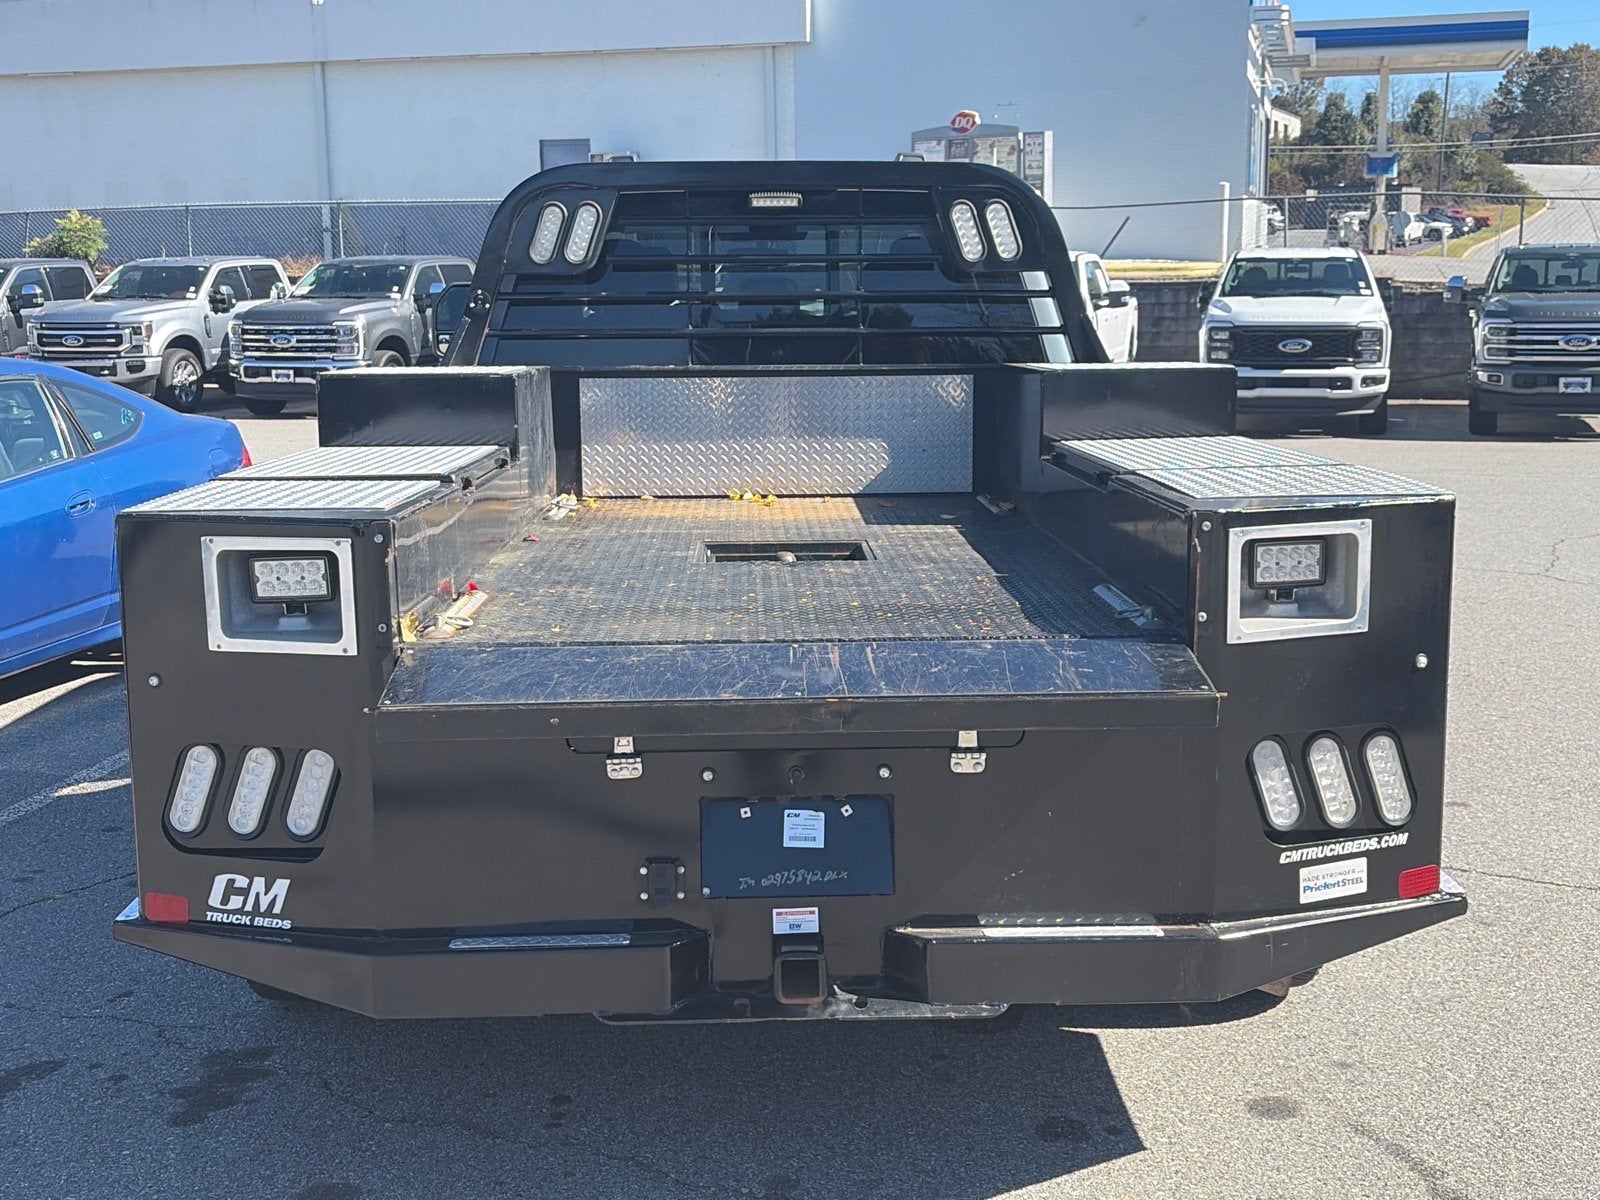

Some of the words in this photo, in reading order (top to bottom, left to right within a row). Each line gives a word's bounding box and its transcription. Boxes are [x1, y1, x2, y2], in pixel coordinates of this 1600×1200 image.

[954, 116, 974, 130] DQ
[1279, 832, 1409, 864] CMTRUCKBEDS.COM
[1302, 874, 1320, 883] MADE
[1321, 868, 1356, 880] STRONGER
[207, 873, 291, 914] CM
[206, 911, 251, 926] TRUCK
[253, 917, 292, 930] BEDS
